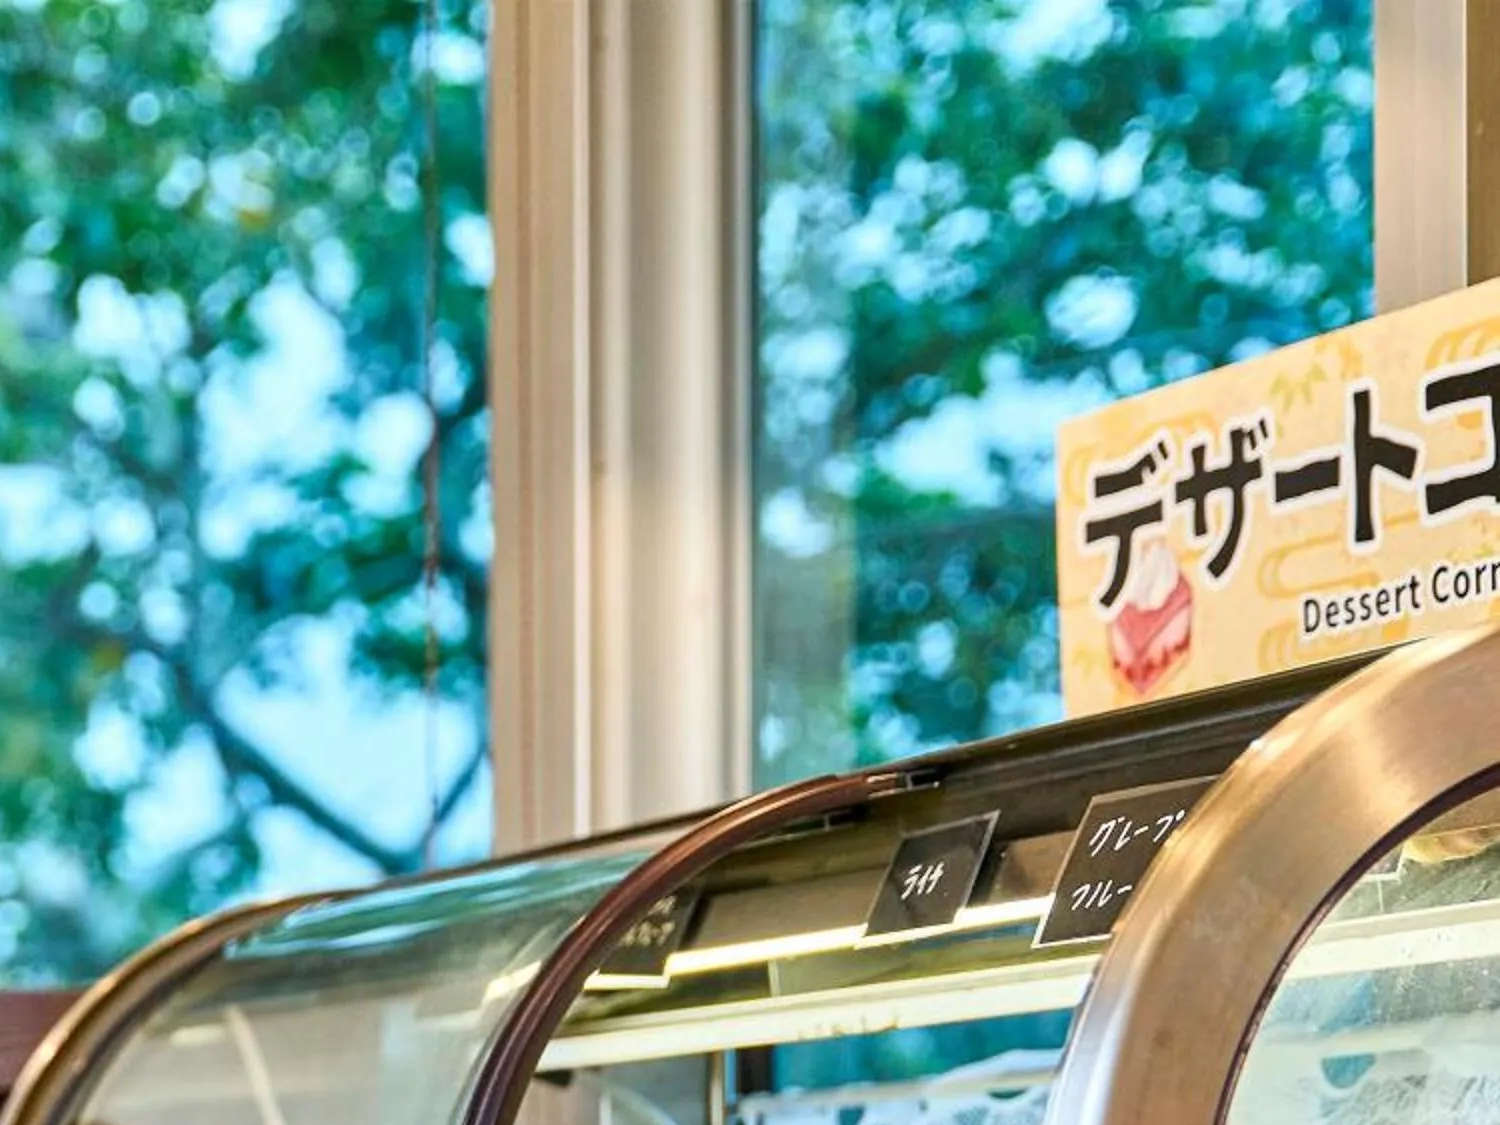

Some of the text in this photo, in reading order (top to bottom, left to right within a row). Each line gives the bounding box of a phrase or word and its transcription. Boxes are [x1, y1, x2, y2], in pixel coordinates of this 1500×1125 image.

[1086, 364, 1500, 608] デザートコ
[1303, 575, 1421, 633] Dessert
[1070, 879, 1133, 911] フルー
